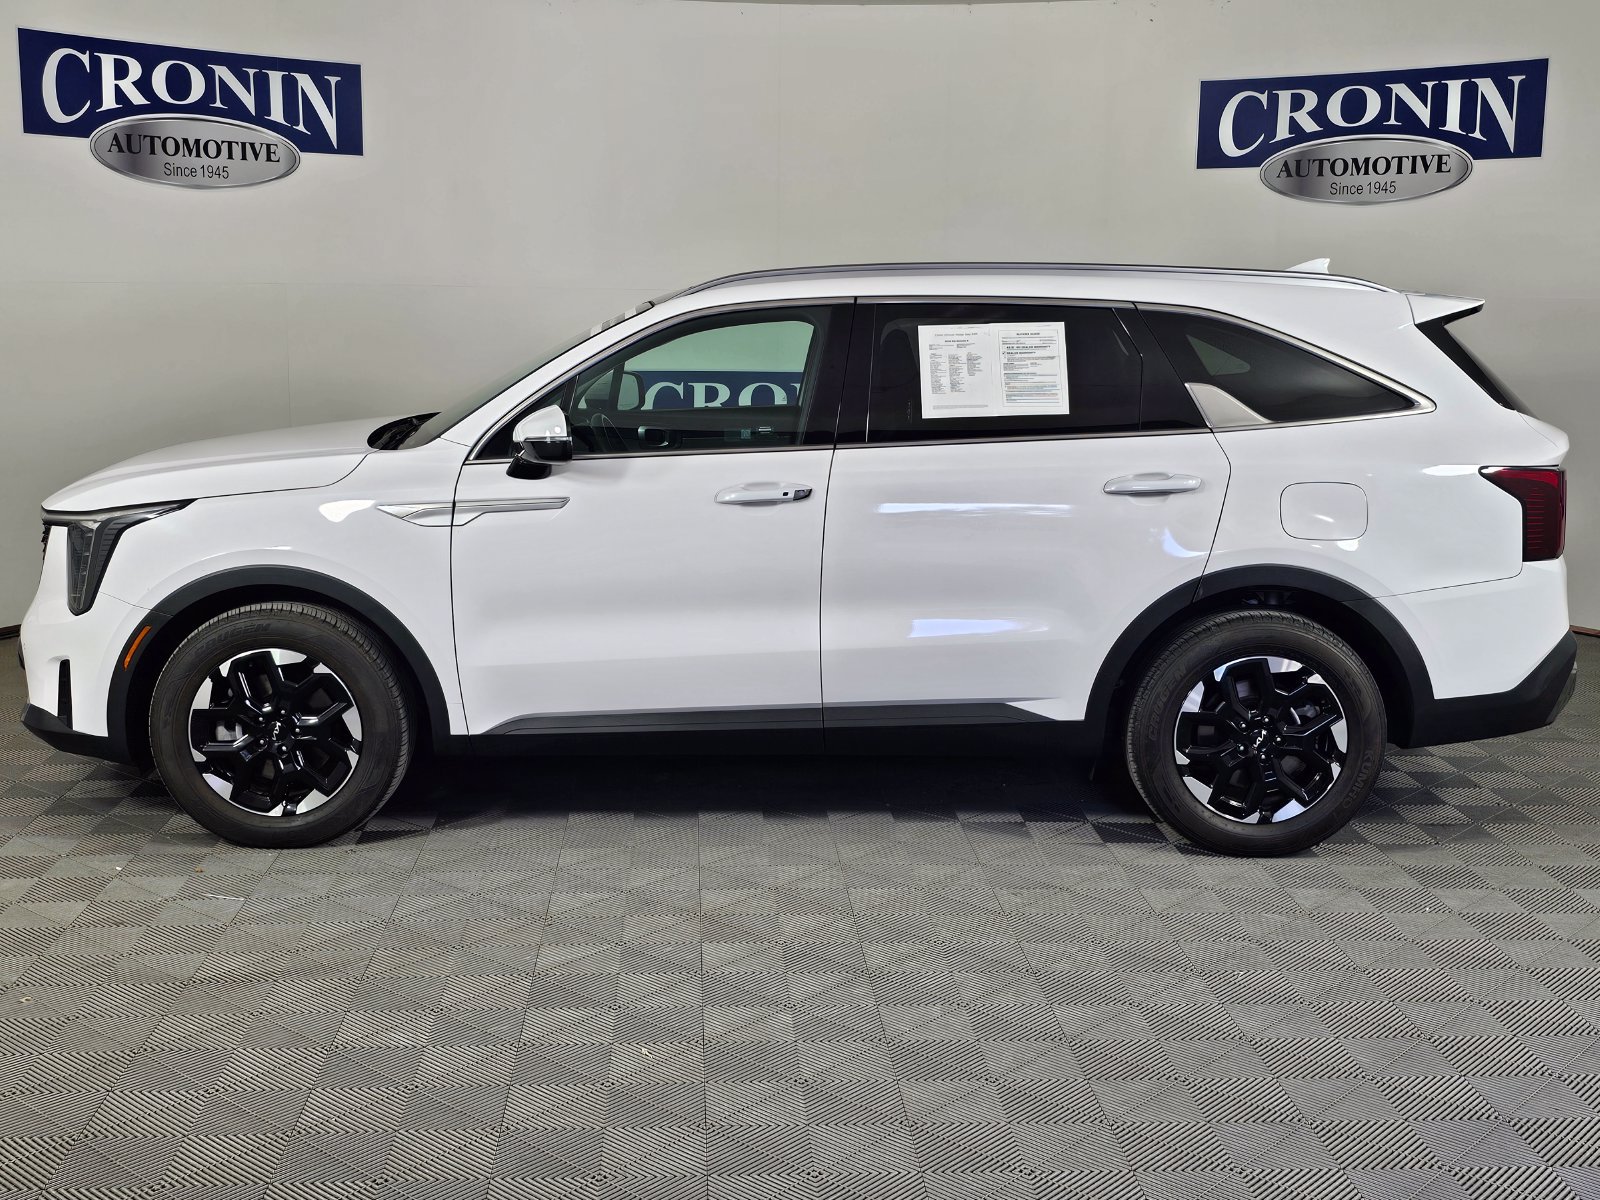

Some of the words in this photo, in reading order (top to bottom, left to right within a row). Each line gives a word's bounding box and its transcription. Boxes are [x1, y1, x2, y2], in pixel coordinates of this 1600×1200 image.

[42, 47, 342, 149] CRONIN
[1218, 75, 1526, 157] CRONIN
[107, 132, 281, 163] AUTOMOTIVE
[163, 162, 198, 178] Since
[200, 164, 230, 180] 1945
[1276, 154, 1451, 179] AUTOMOTIVE
[1329, 181, 1364, 196] Since
[1366, 180, 1397, 195] 1945
[641, 381, 800, 411] CRO
[1342, 750, 1375, 809] KUMHO
